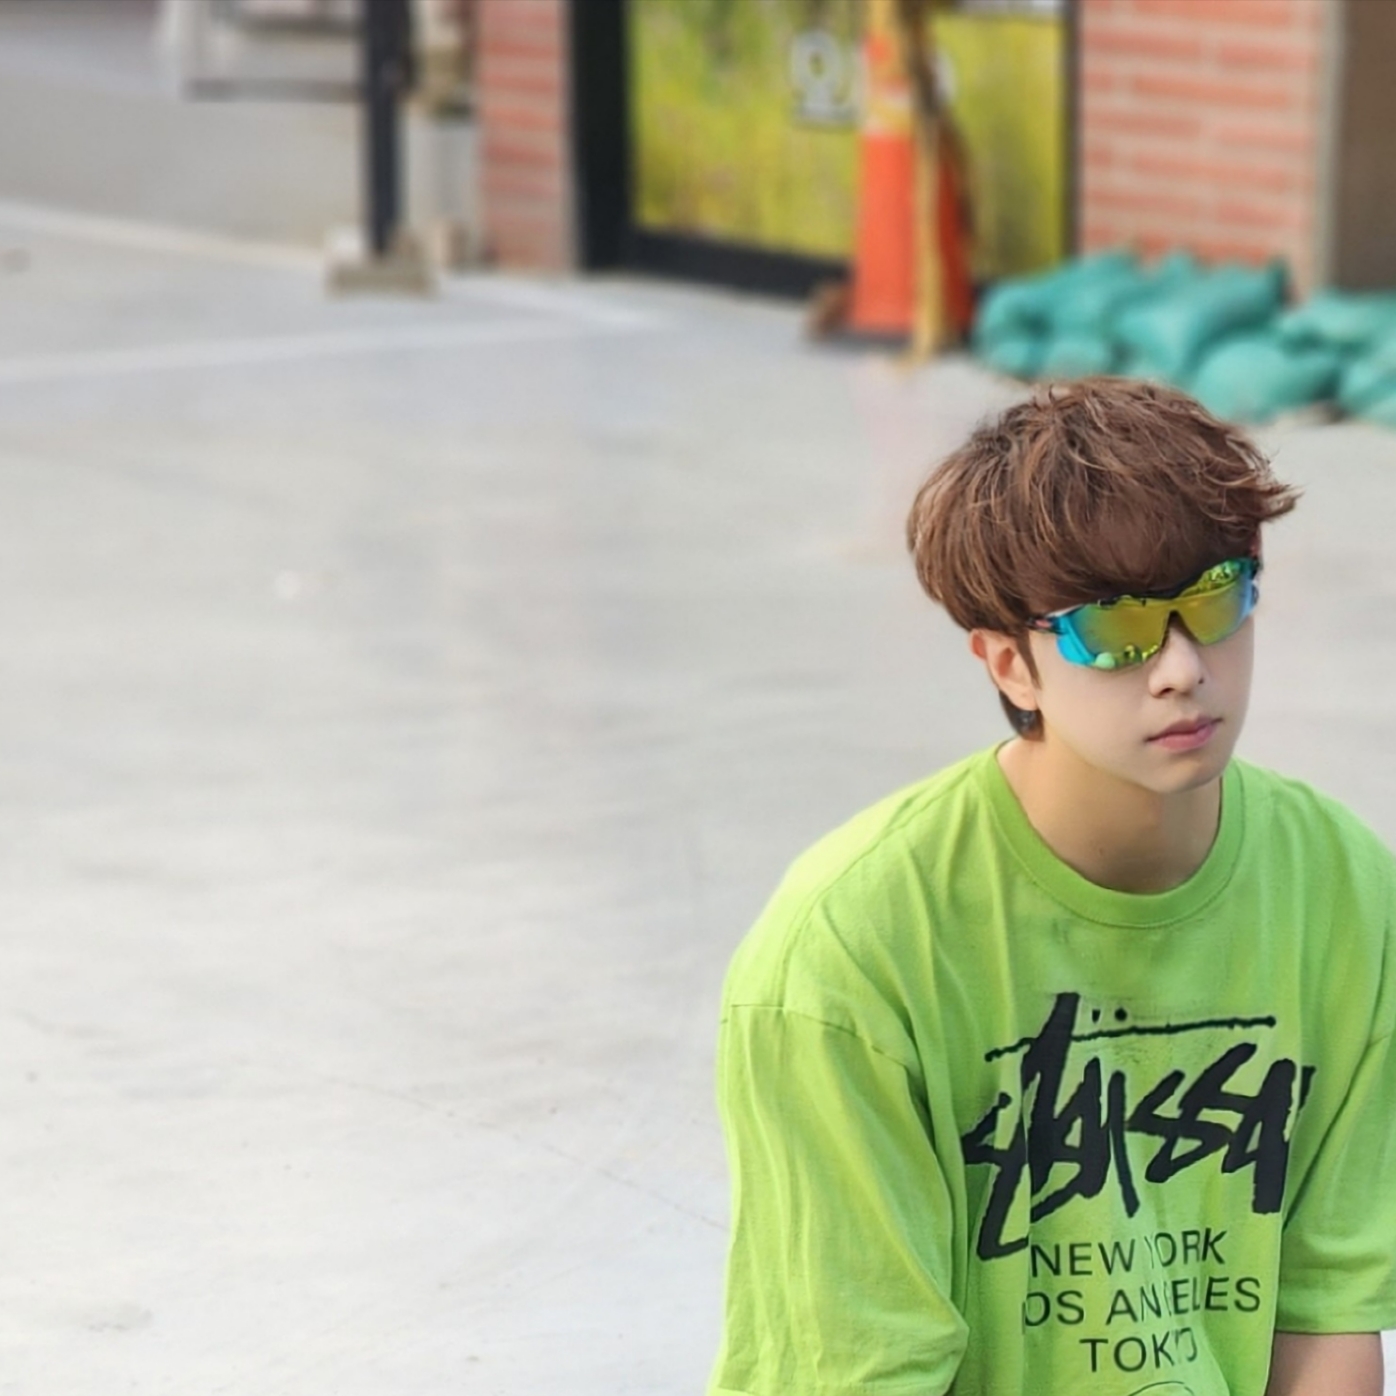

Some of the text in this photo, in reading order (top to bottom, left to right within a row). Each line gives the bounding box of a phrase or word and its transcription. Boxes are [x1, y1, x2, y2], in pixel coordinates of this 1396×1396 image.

[1031, 1239, 1135, 1277] NEW
[1022, 1277, 1261, 1328] OS ANELES
[1079, 1327, 1198, 1373] TOKO
